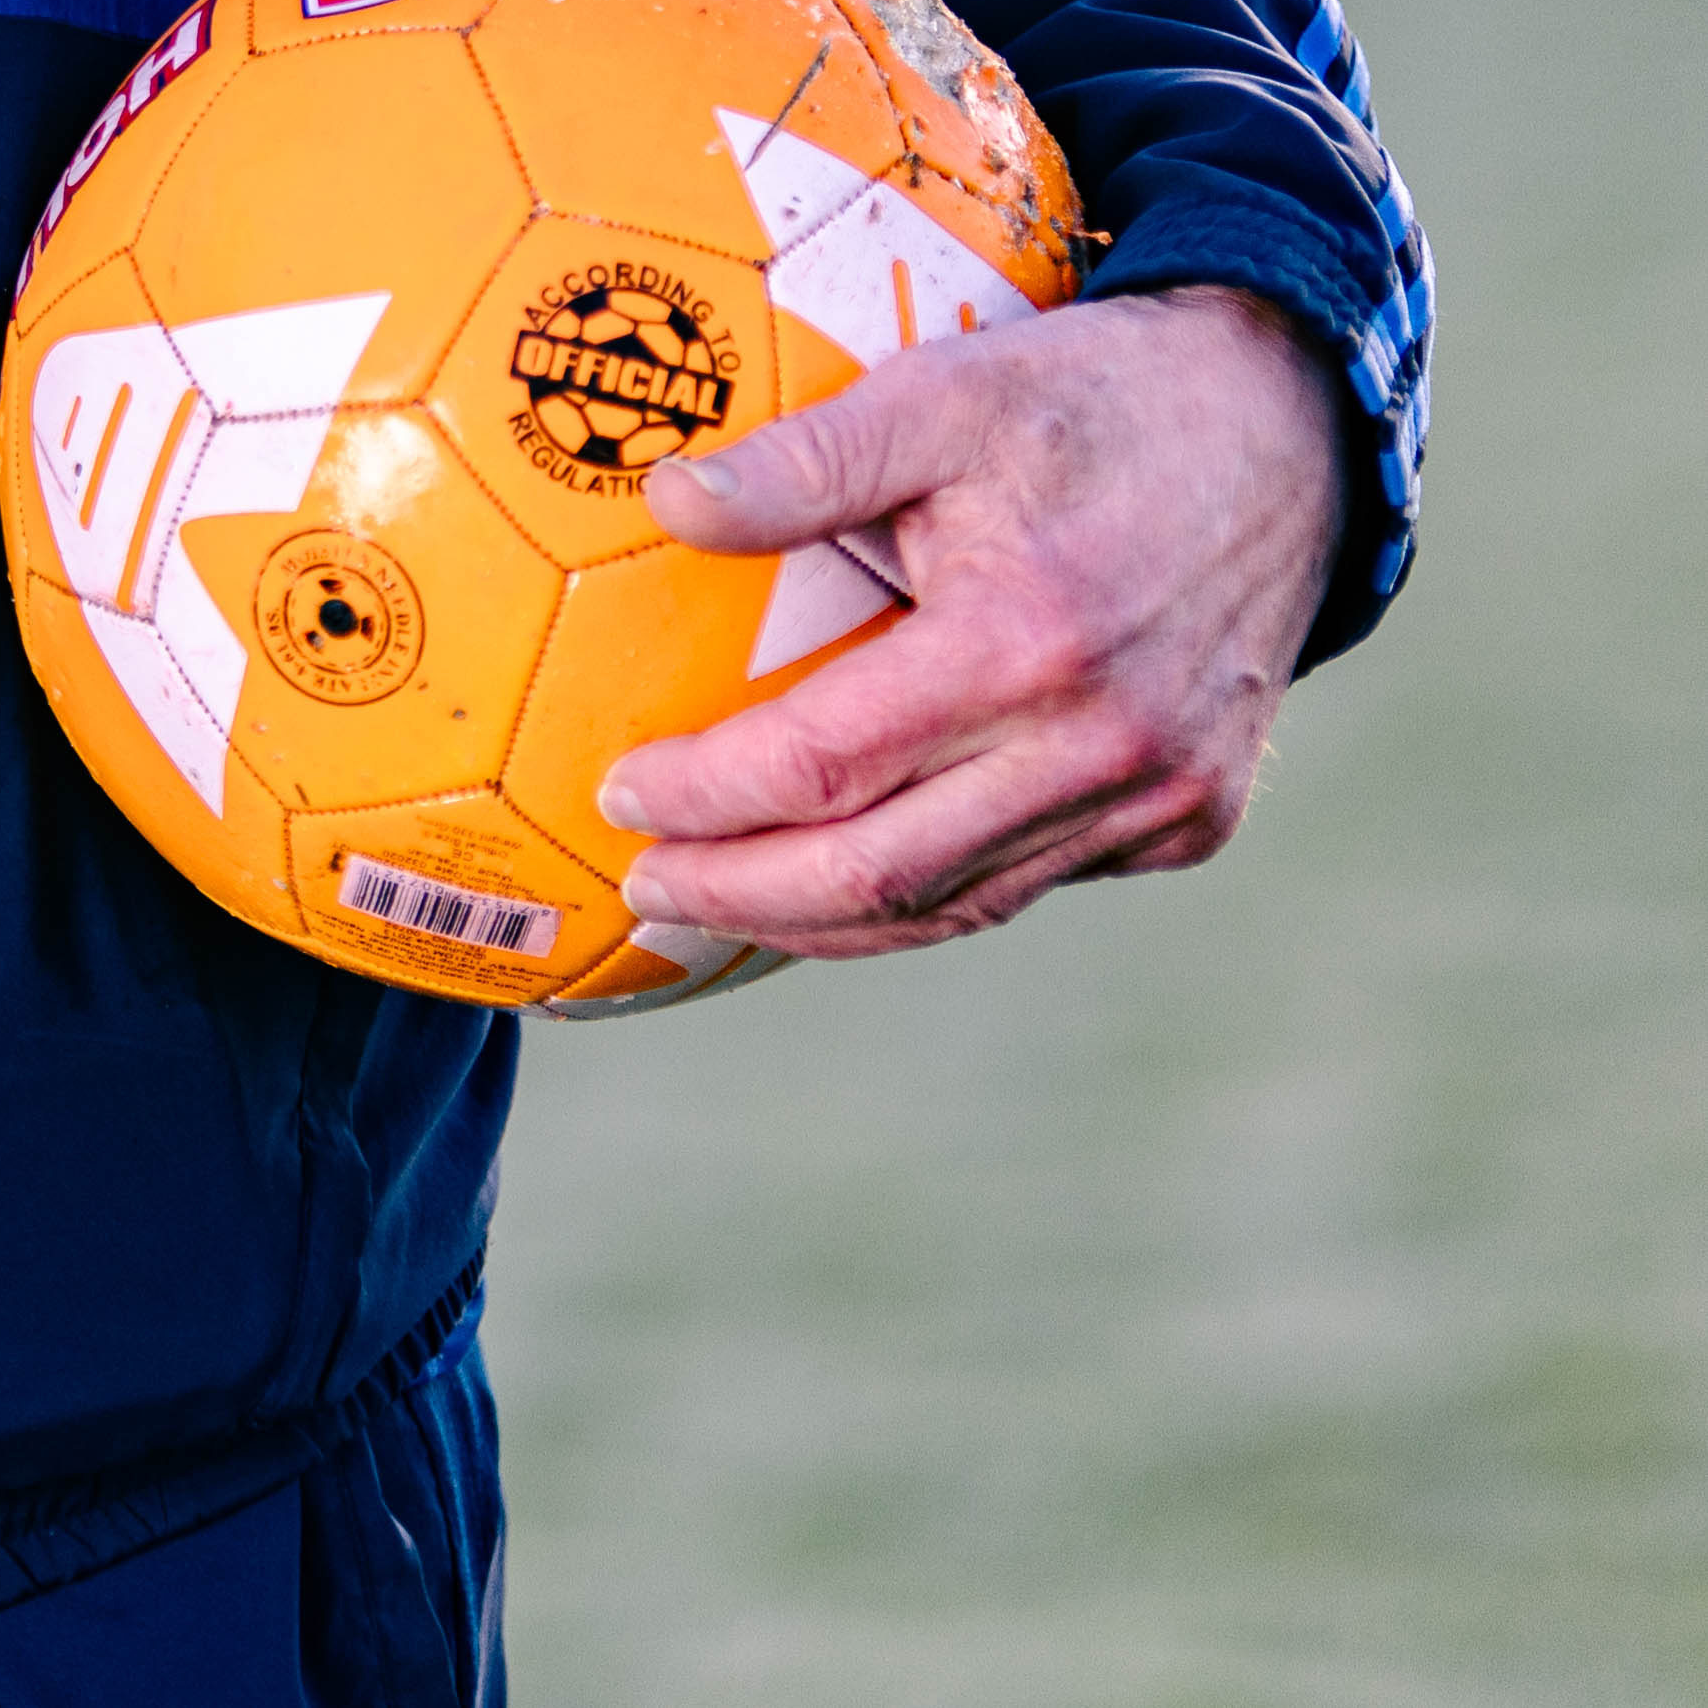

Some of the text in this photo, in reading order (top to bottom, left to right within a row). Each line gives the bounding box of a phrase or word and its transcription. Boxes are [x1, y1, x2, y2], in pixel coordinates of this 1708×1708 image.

[524, 262, 741, 373] ACCORDING TO
[516, 336, 723, 421] OFFICIAL
